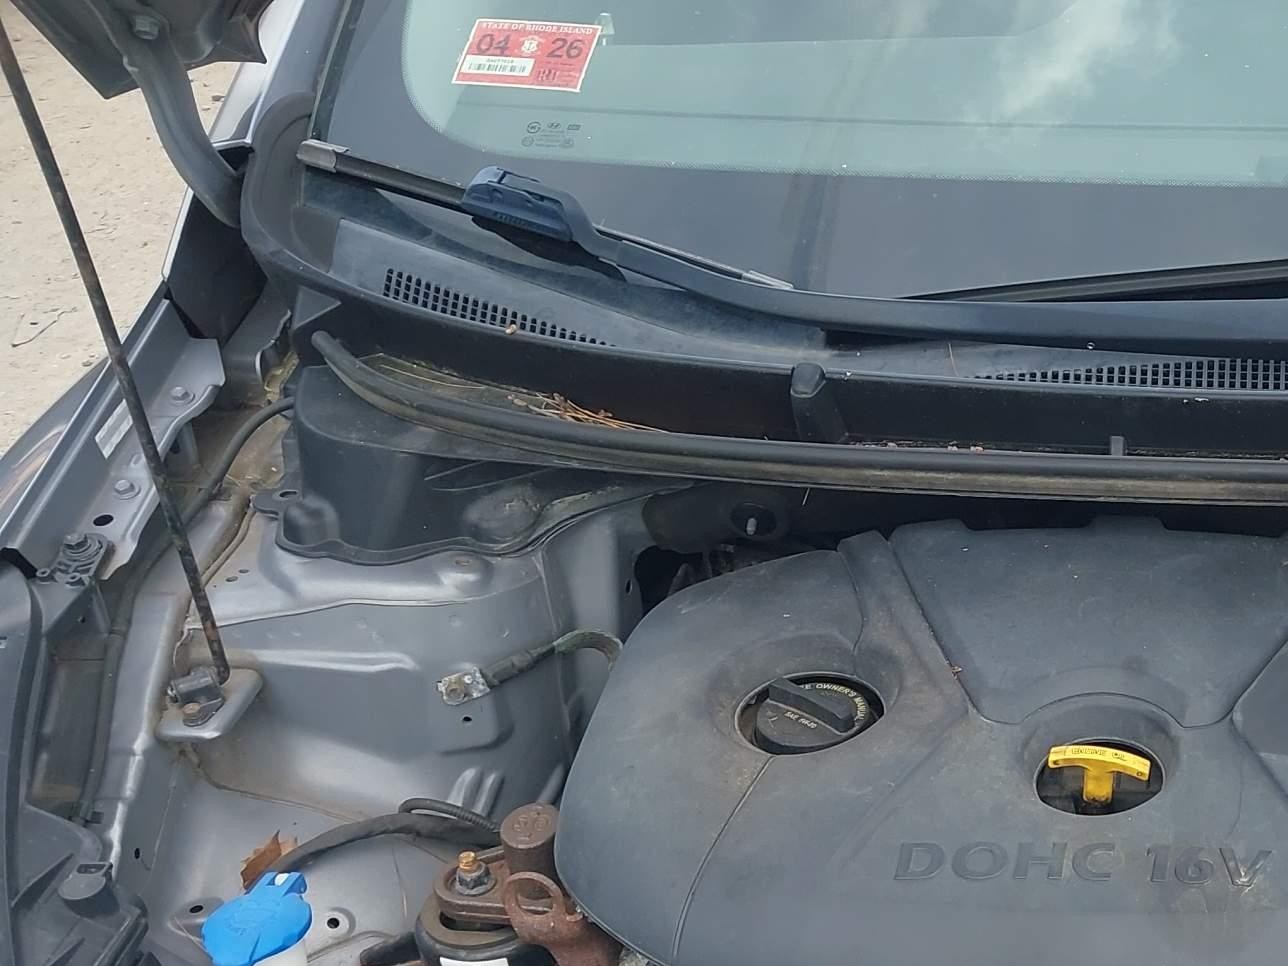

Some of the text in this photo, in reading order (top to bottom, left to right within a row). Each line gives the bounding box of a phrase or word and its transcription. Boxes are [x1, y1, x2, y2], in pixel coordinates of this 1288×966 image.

[481, 22, 511, 30] STATE
[525, 24, 557, 33] RHODE
[559, 27, 593, 35] ISLAND
[476, 33, 585, 59] 04 26
[815, 683, 857, 698] OWNER'S
[1071, 747, 1107, 757] ENGINE
[893, 841, 1273, 888] DOHC 16V
